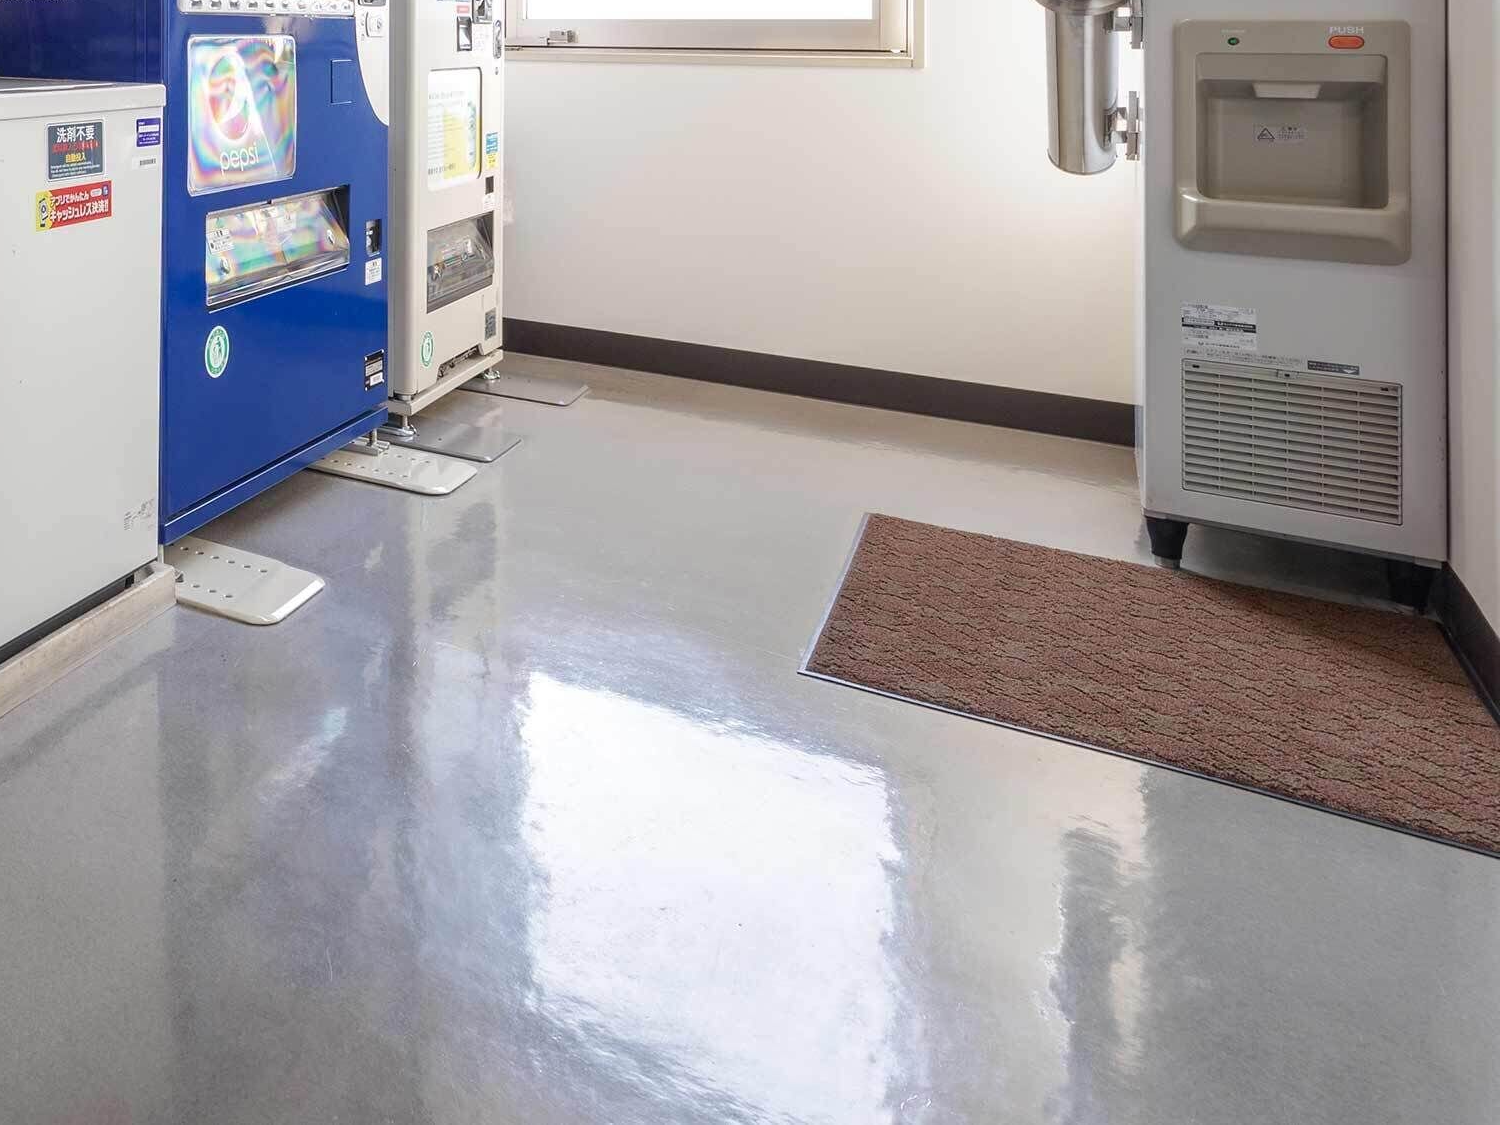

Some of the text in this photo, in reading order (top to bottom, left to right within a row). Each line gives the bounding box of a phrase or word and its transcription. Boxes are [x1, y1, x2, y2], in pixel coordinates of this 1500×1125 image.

[1328, 26, 1366, 35] PUSH
[56, 124, 96, 144] 洗剤不要
[219, 140, 261, 174] pepsi
